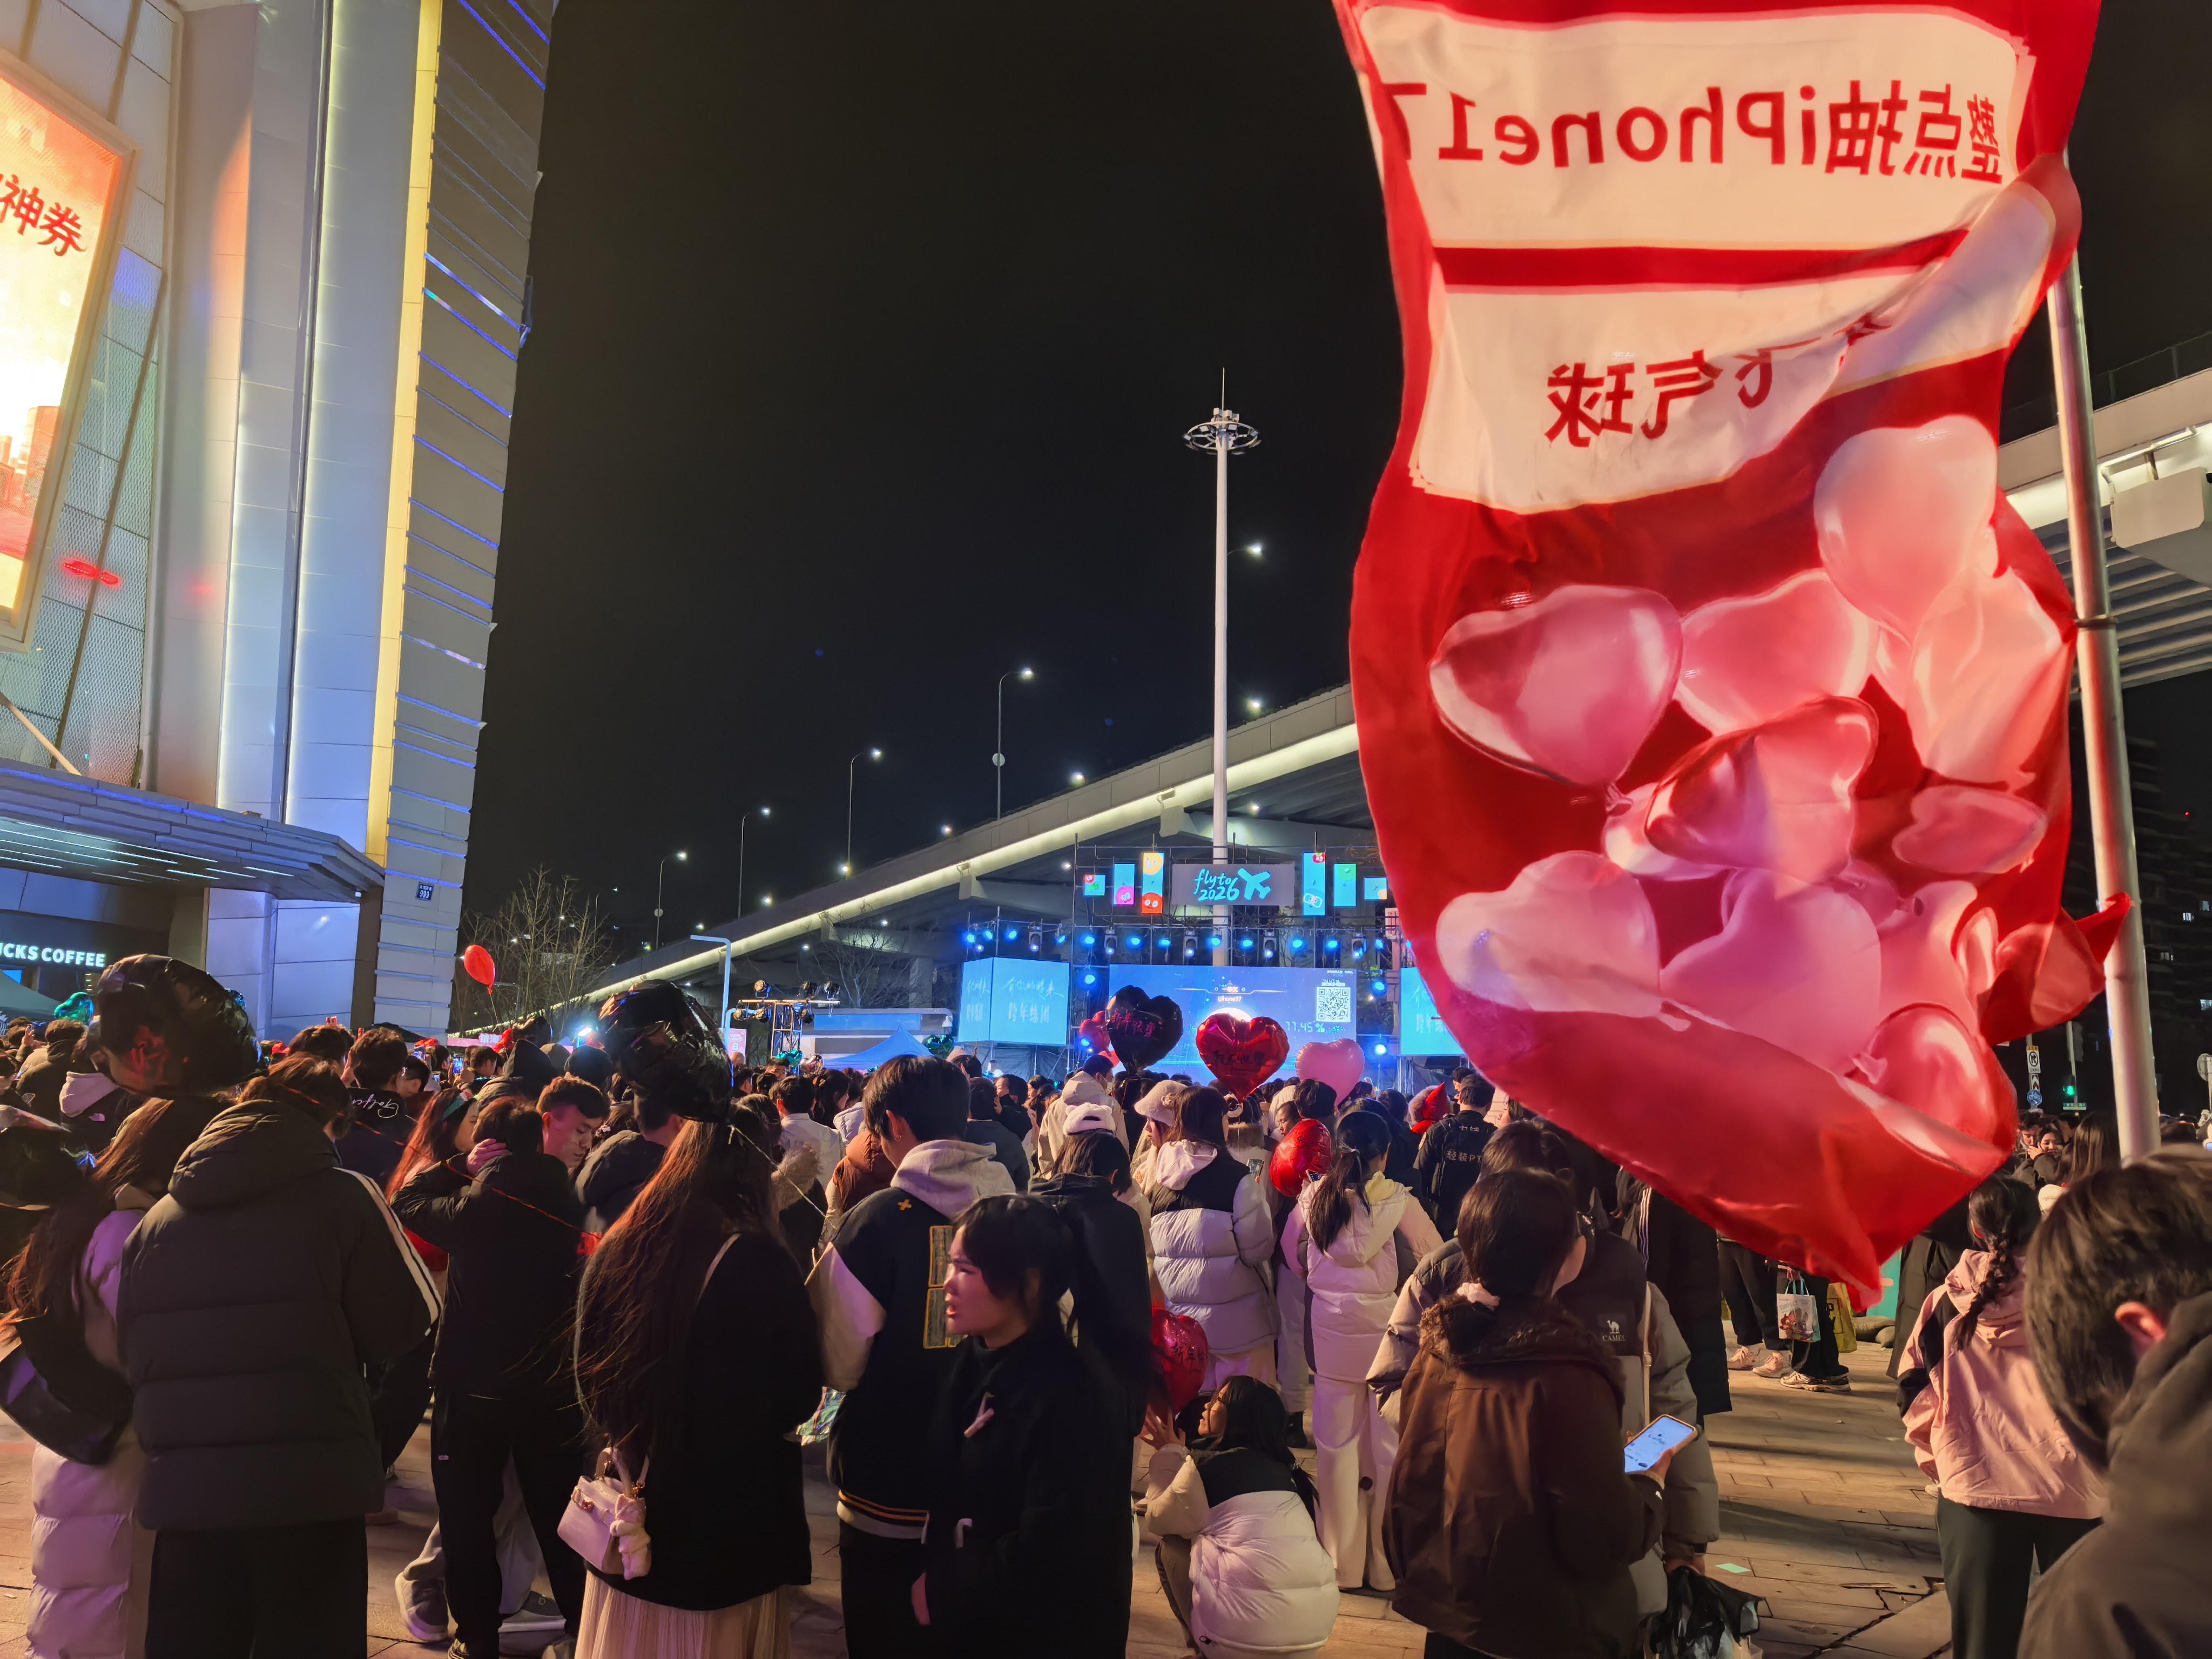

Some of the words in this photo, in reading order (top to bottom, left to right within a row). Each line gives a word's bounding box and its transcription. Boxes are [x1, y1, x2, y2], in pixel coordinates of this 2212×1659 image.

[0, 174, 86, 257] 神券
[1198, 877, 1240, 901] 2026
[0, 943, 39, 960] CKS
[42, 947, 106, 967] COFFEE
